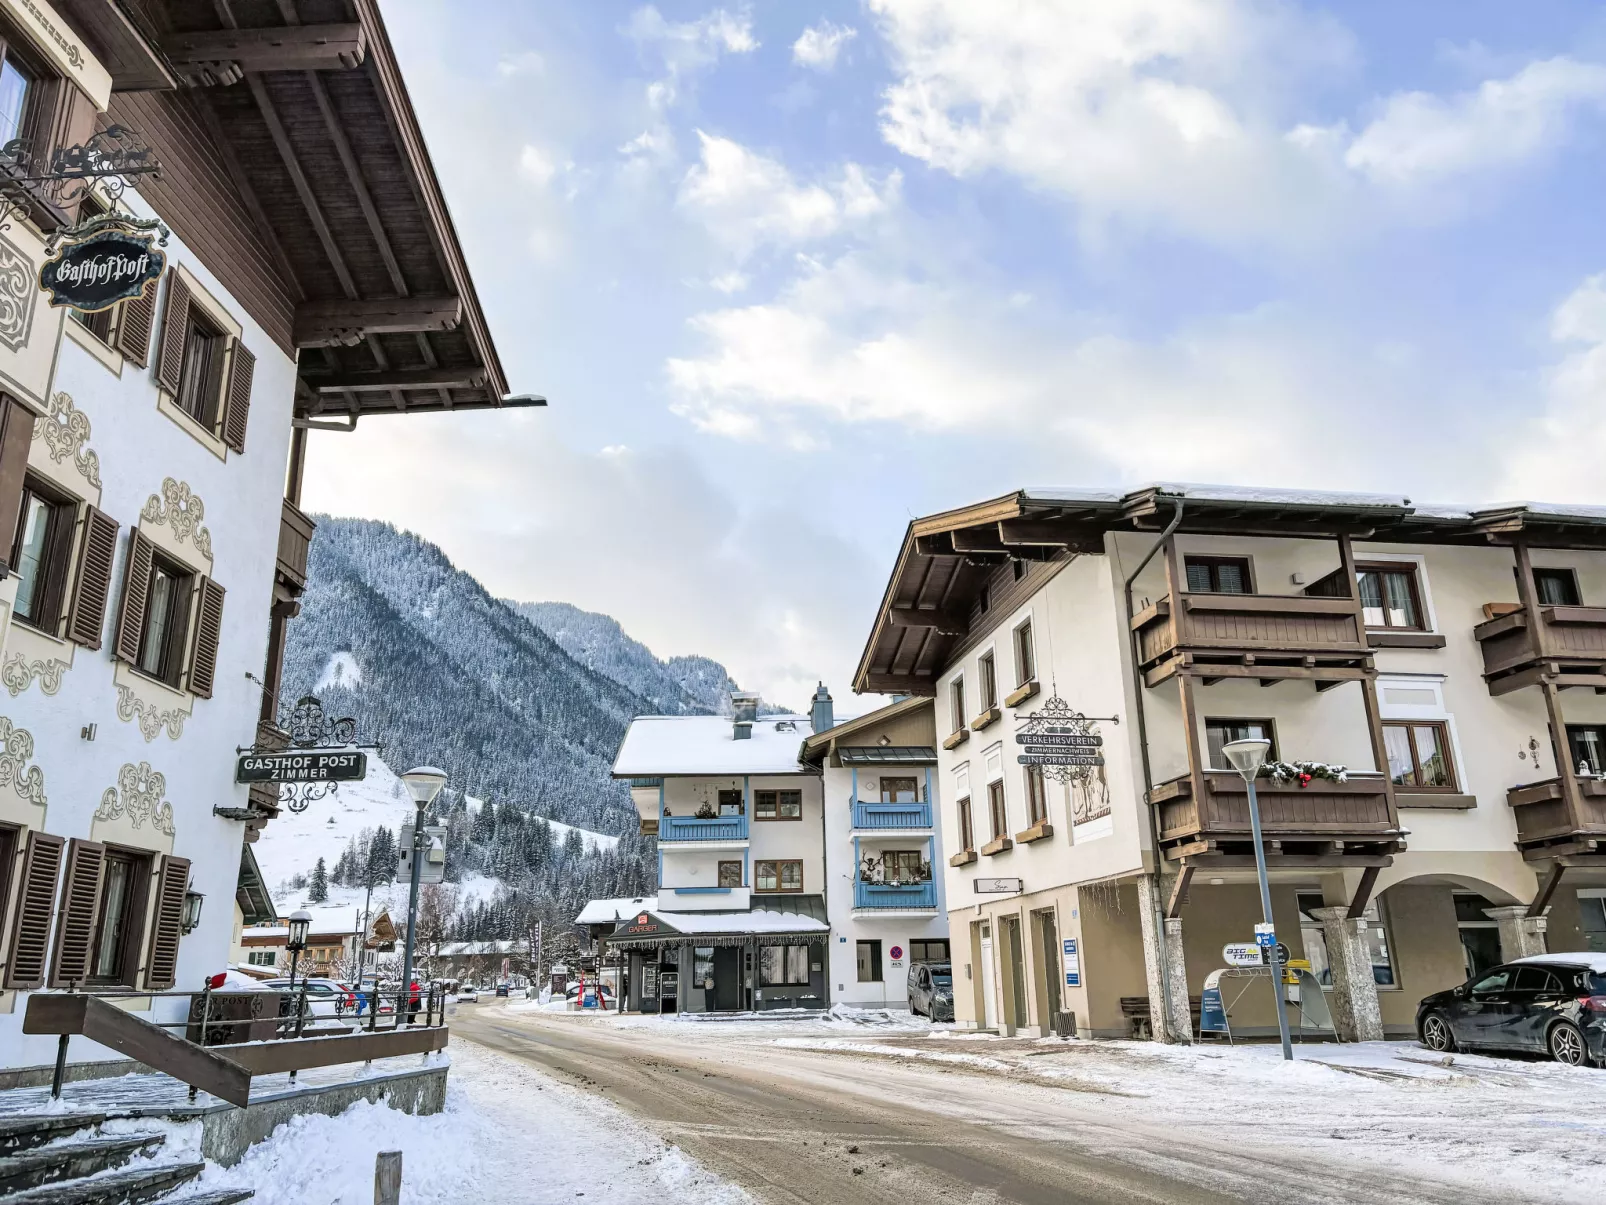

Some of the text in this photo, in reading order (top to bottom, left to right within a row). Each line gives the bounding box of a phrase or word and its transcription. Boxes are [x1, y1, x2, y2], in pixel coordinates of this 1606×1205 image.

[55, 252, 150, 288] Gasthof Post
[1021, 735, 1098, 745] VERKEHRSVEREIN
[243, 755, 357, 770] GASTHOF POST
[1027, 756, 1096, 765] INFORMATION
[270, 768, 328, 779] ZIMMER
[628, 924, 657, 933] GARGER
[222, 996, 250, 1005] POST
